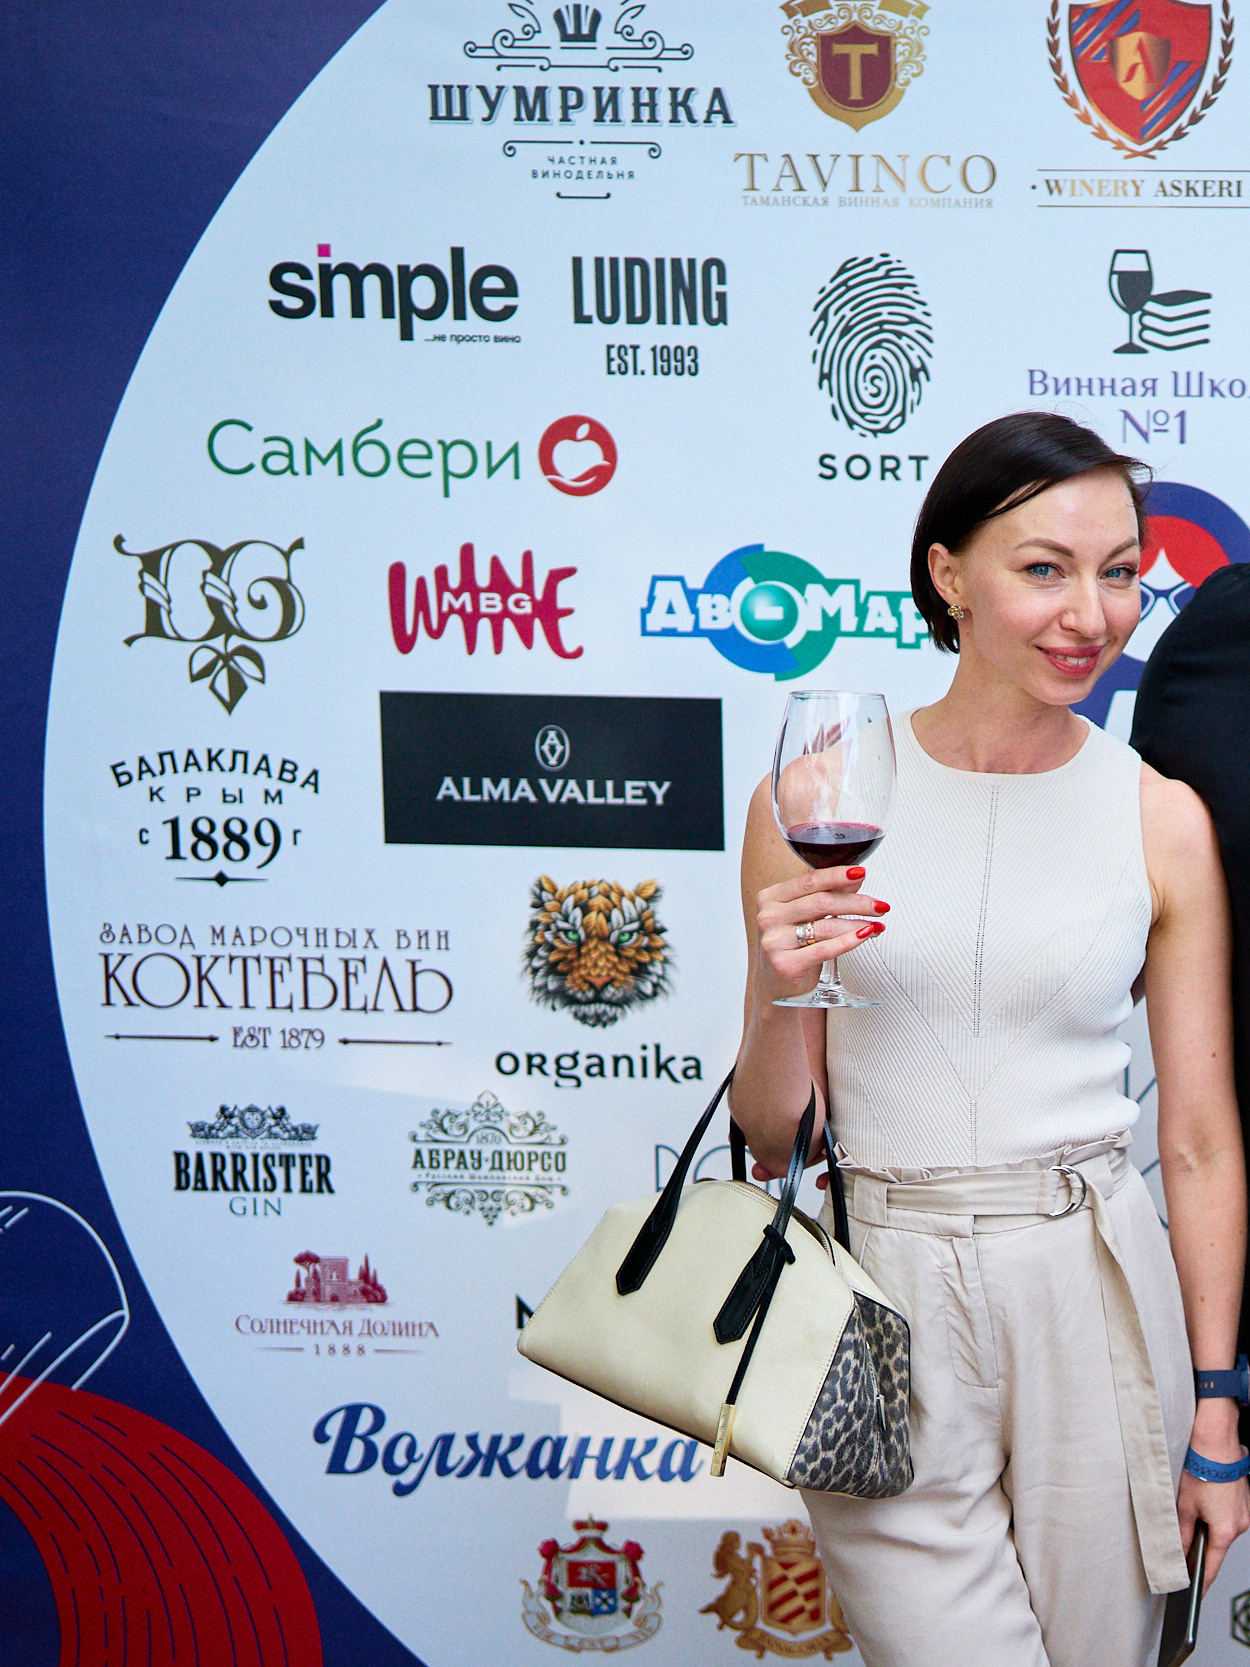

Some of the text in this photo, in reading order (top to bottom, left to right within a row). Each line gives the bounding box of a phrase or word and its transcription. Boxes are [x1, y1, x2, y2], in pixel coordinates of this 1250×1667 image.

[428, 84, 736, 126] ШУМРИНКА
[531, 169, 635, 180] ВИНОДЕЛЬНЯ
[547, 155, 618, 166] ЧАСТНАЯ
[734, 152, 997, 194] TAVINCO
[742, 195, 994, 209] ТАМАНСКАЯ ВИННАЯ КОМПАНИЯ
[1044, 179, 1243, 198] WINERY ASKERI
[268, 243, 519, 341] simple
[572, 256, 728, 326] LUDING
[450, 334, 490, 344] просто
[493, 335, 521, 343] вино
[606, 344, 699, 376] EST. 1993
[1028, 369, 1158, 398] Винная
[1119, 409, 1187, 444] №1
[206, 418, 520, 498] Самбери
[818, 453, 929, 481] SORT
[388, 542, 584, 659] WINE
[441, 590, 533, 614] MBG
[109, 748, 320, 794] БАЛАКЛАВА
[149, 786, 283, 804] КРЫМ
[436, 775, 670, 806] ALMA VALLEY
[162, 815, 281, 869] 1889
[100, 922, 451, 951] ЗАВОД МАРОЧНЫХ ВИН
[100, 951, 454, 1014] КОКТЕБЕЛЬ
[232, 1026, 325, 1050] EST 1879
[173, 1150, 335, 1194] BARRISTER
[229, 1196, 282, 1216] GIN
[313, 1343, 366, 1355] 1888
[312, 1402, 702, 1498] Волжанка
